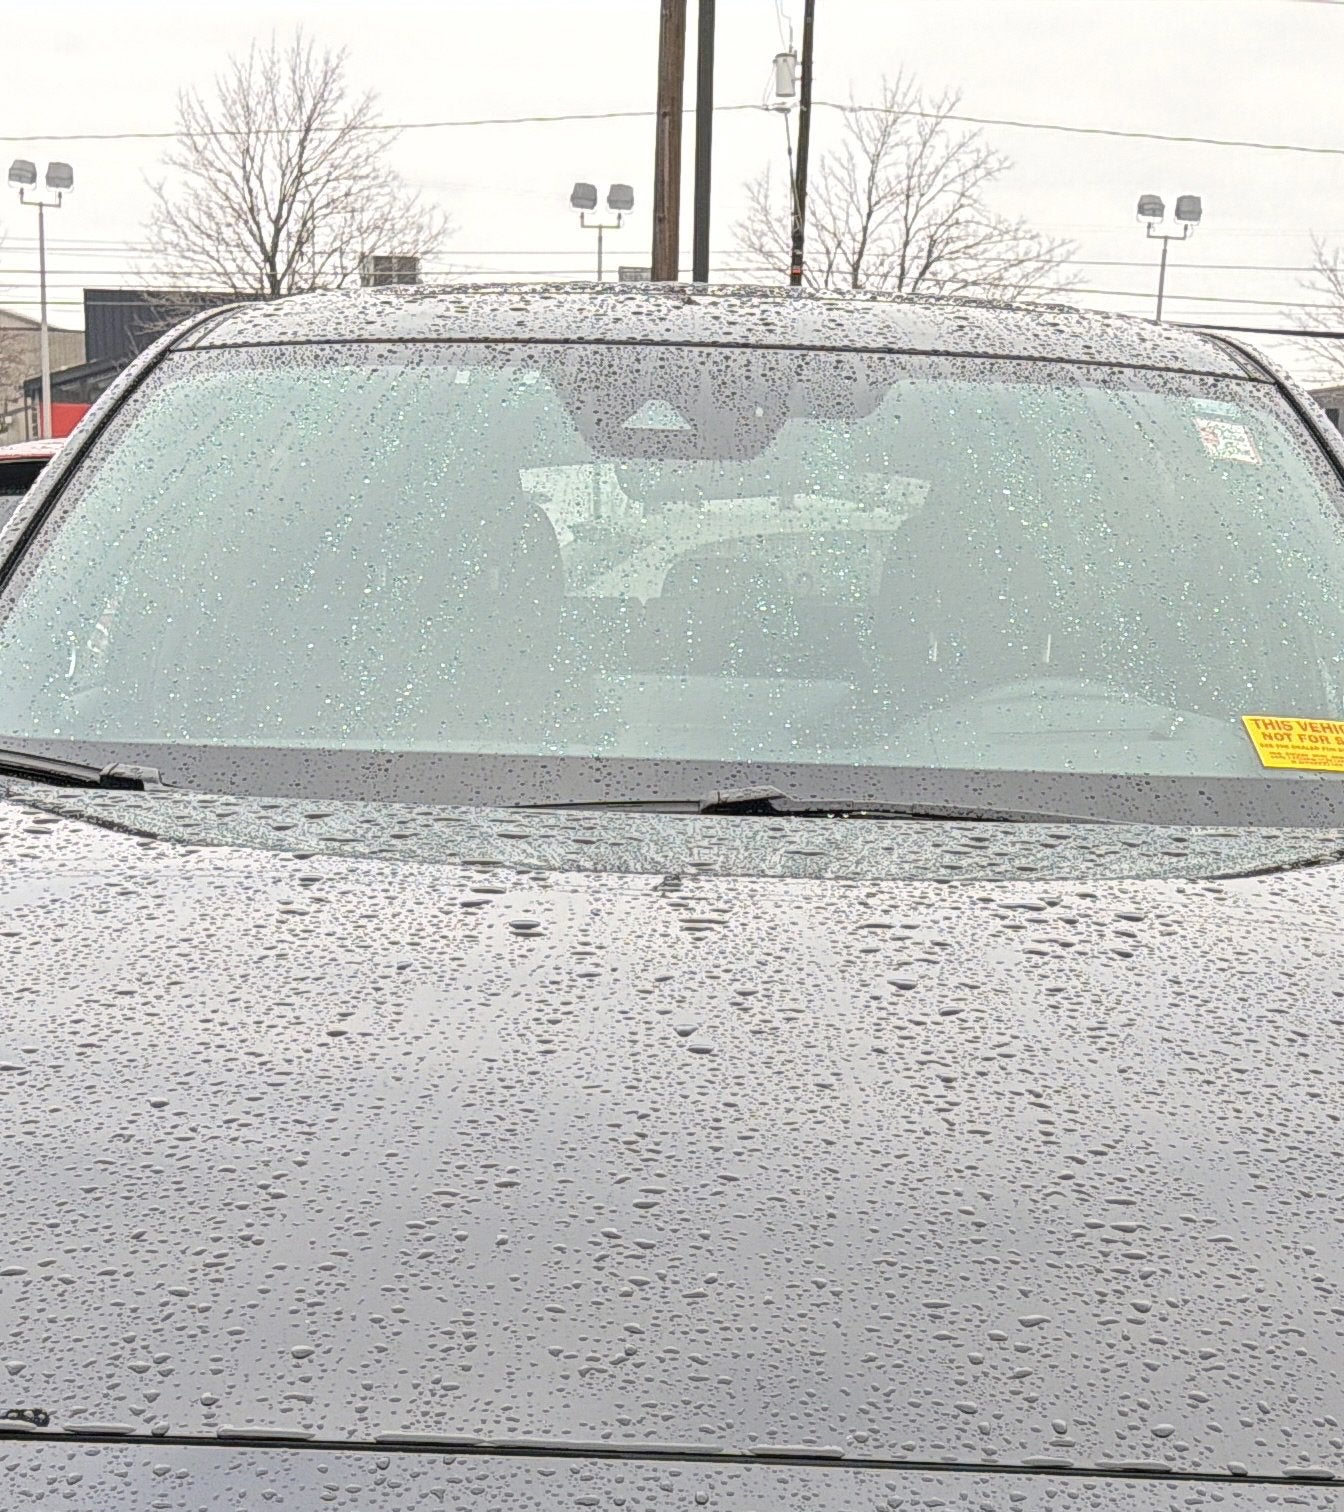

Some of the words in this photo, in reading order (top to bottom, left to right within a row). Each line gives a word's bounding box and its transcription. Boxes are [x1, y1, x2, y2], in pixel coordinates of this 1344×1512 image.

[1253, 719, 1293, 731] THIS
[1262, 731, 1293, 743] NOT
[1299, 733, 1329, 745] FOR
